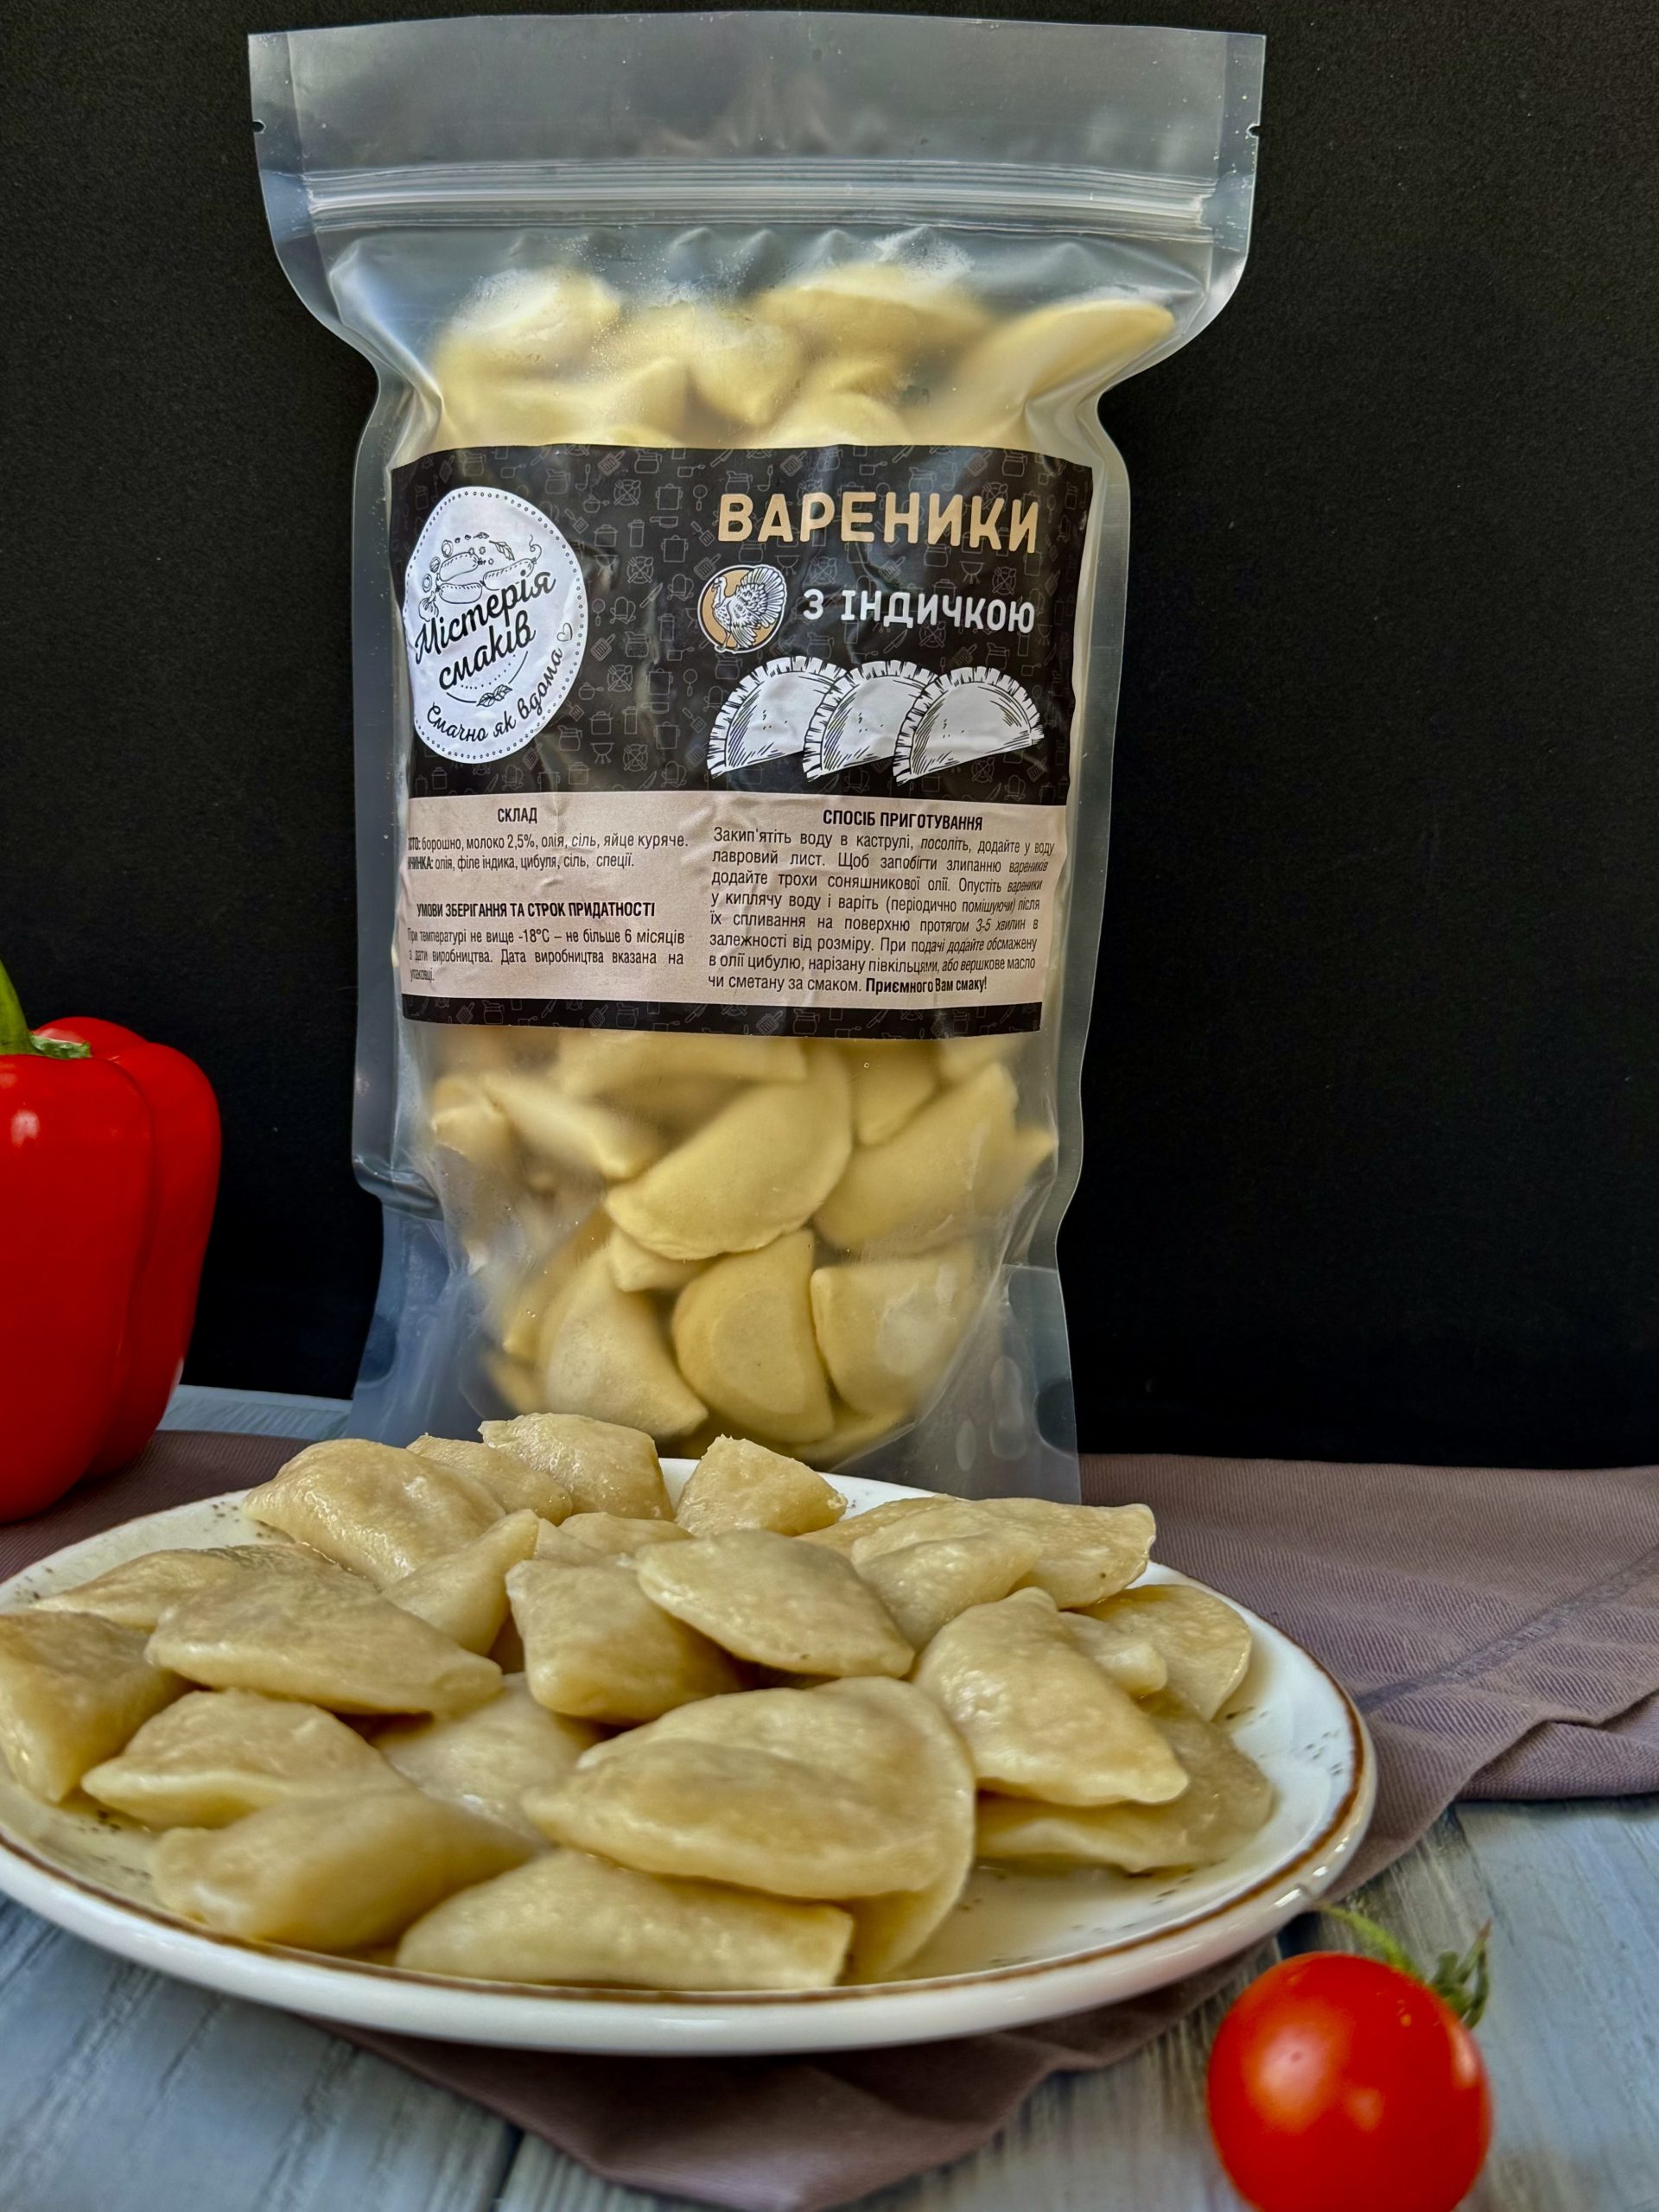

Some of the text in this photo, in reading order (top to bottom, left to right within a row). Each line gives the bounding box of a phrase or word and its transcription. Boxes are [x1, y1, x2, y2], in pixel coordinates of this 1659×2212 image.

[718, 491, 1039, 553] ВАРЕНИКИ
[415, 569, 556, 665] Містерія
[803, 588, 1035, 634] З ІНДИЧКОЮ
[439, 609, 537, 690] смаків
[427, 648, 563, 742] Смачно як вдома
[498, 808, 537, 823] СКЛАД
[823, 809, 983, 831] СПОСІБ ПРИГОТУВАННЯ
[422, 836, 464, 853] борошно,
[467, 837, 505, 849] молоко
[507, 835, 538, 849] 2,5%,
[541, 835, 568, 849] олія,
[571, 835, 601, 849] сіль,
[604, 835, 634, 850] яйце
[638, 836, 689, 849] куряче.
[714, 826, 1055, 856] Закип'ятіть воду в каструлі, посоліть, додайте у воду
[435, 855, 455, 871] олія,
[457, 855, 480, 872] філе
[482, 855, 518, 870] індика,
[520, 853, 561, 870] цибуля,
[563, 854, 589, 870] сіль,
[596, 854, 634, 870] спеції.
[711, 849, 1048, 875] лавровий лист. Щоб запобігти злипанню вареників
[711, 871, 1043, 895] додайте трохи соняшникової олії. Опустіть вареники
[416, 902, 655, 918] УМОВИ ЗБЕРІГАННЯ ТА СТРОК ПРИДАТНОСТІ
[710, 893, 1040, 914] у киплячу воду і варіть (періодично помішуючи) після
[709, 912, 1039, 935] їх спливання на поверхню протягом 3-5 хвилин в
[420, 929, 467, 945] температурі
[470, 932, 482, 943] не
[486, 931, 514, 944] вище
[566, 932, 579, 943] не
[582, 927, 621, 943] більше
[625, 929, 632, 943] 6
[636, 931, 685, 946] місяців
[709, 933, 1038, 955] залежності від розміру. При подачі додайте обсмажену
[432, 949, 493, 964] виробництва.
[500, 949, 526, 965] Дата
[535, 948, 604, 965] виробництва
[612, 953, 657, 964] вказана
[668, 954, 683, 964] на
[709, 951, 1036, 974] в олії цибулю, нарізану півкільцями, або вершкове масло
[708, 976, 988, 995] чи сметану за смаком. Приємного Вам смаку!
